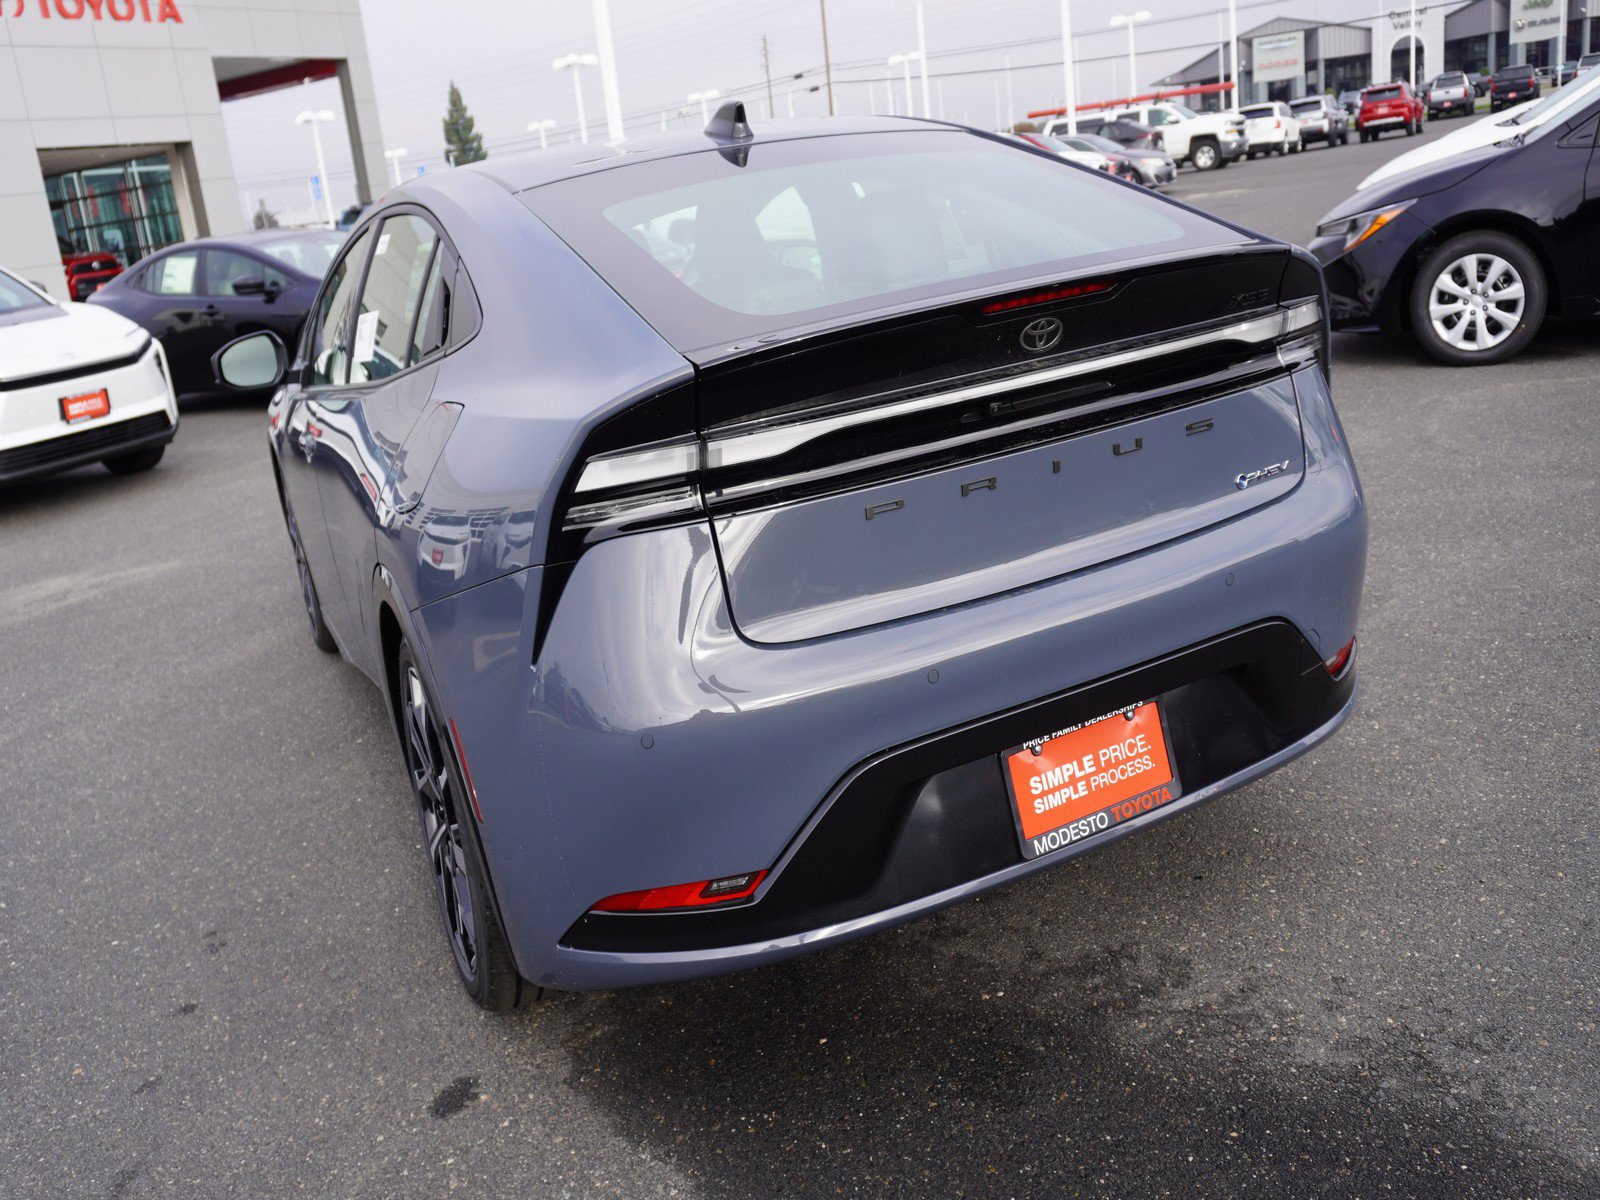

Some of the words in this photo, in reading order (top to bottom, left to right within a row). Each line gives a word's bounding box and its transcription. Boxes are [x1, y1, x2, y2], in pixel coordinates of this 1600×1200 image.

[38, 0, 183, 23] TOYOTA
[865, 418, 1214, 520] PRIUS
[1023, 735, 1051, 750] PRICE
[1029, 754, 1096, 795] SIMPLE
[1098, 734, 1152, 767] PRICE.
[1033, 781, 1089, 814] SIMPLE
[1090, 756, 1156, 791] PROCESS.
[1033, 812, 1109, 856] MODESTO
[1110, 786, 1173, 823] TOYOTA
